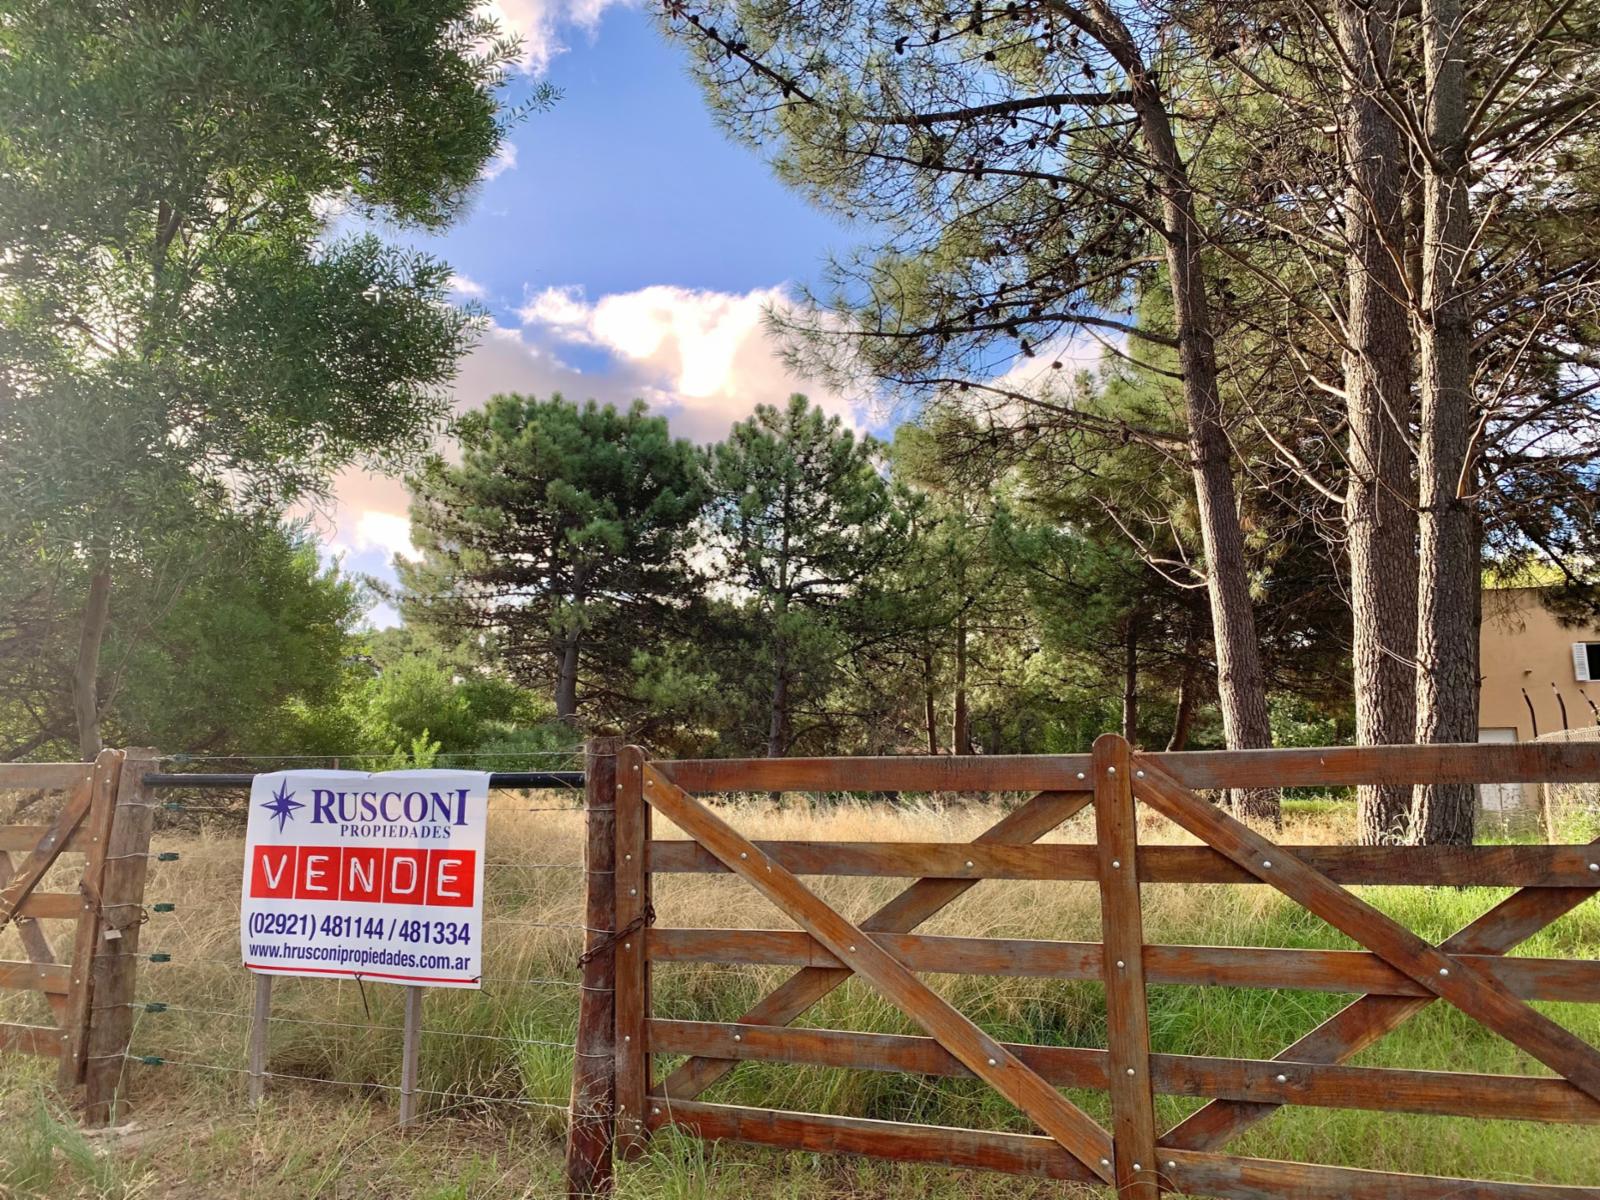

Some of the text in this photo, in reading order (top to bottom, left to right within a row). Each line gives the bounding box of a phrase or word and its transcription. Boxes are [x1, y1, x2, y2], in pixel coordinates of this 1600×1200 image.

[311, 788, 470, 826] RUSCONI
[340, 824, 452, 839] PROPIEDADES
[262, 854, 463, 898] VENDE
[248, 912, 316, 941] (02921)
[249, 943, 471, 970] www.hrusconipropiedades.com.ar
